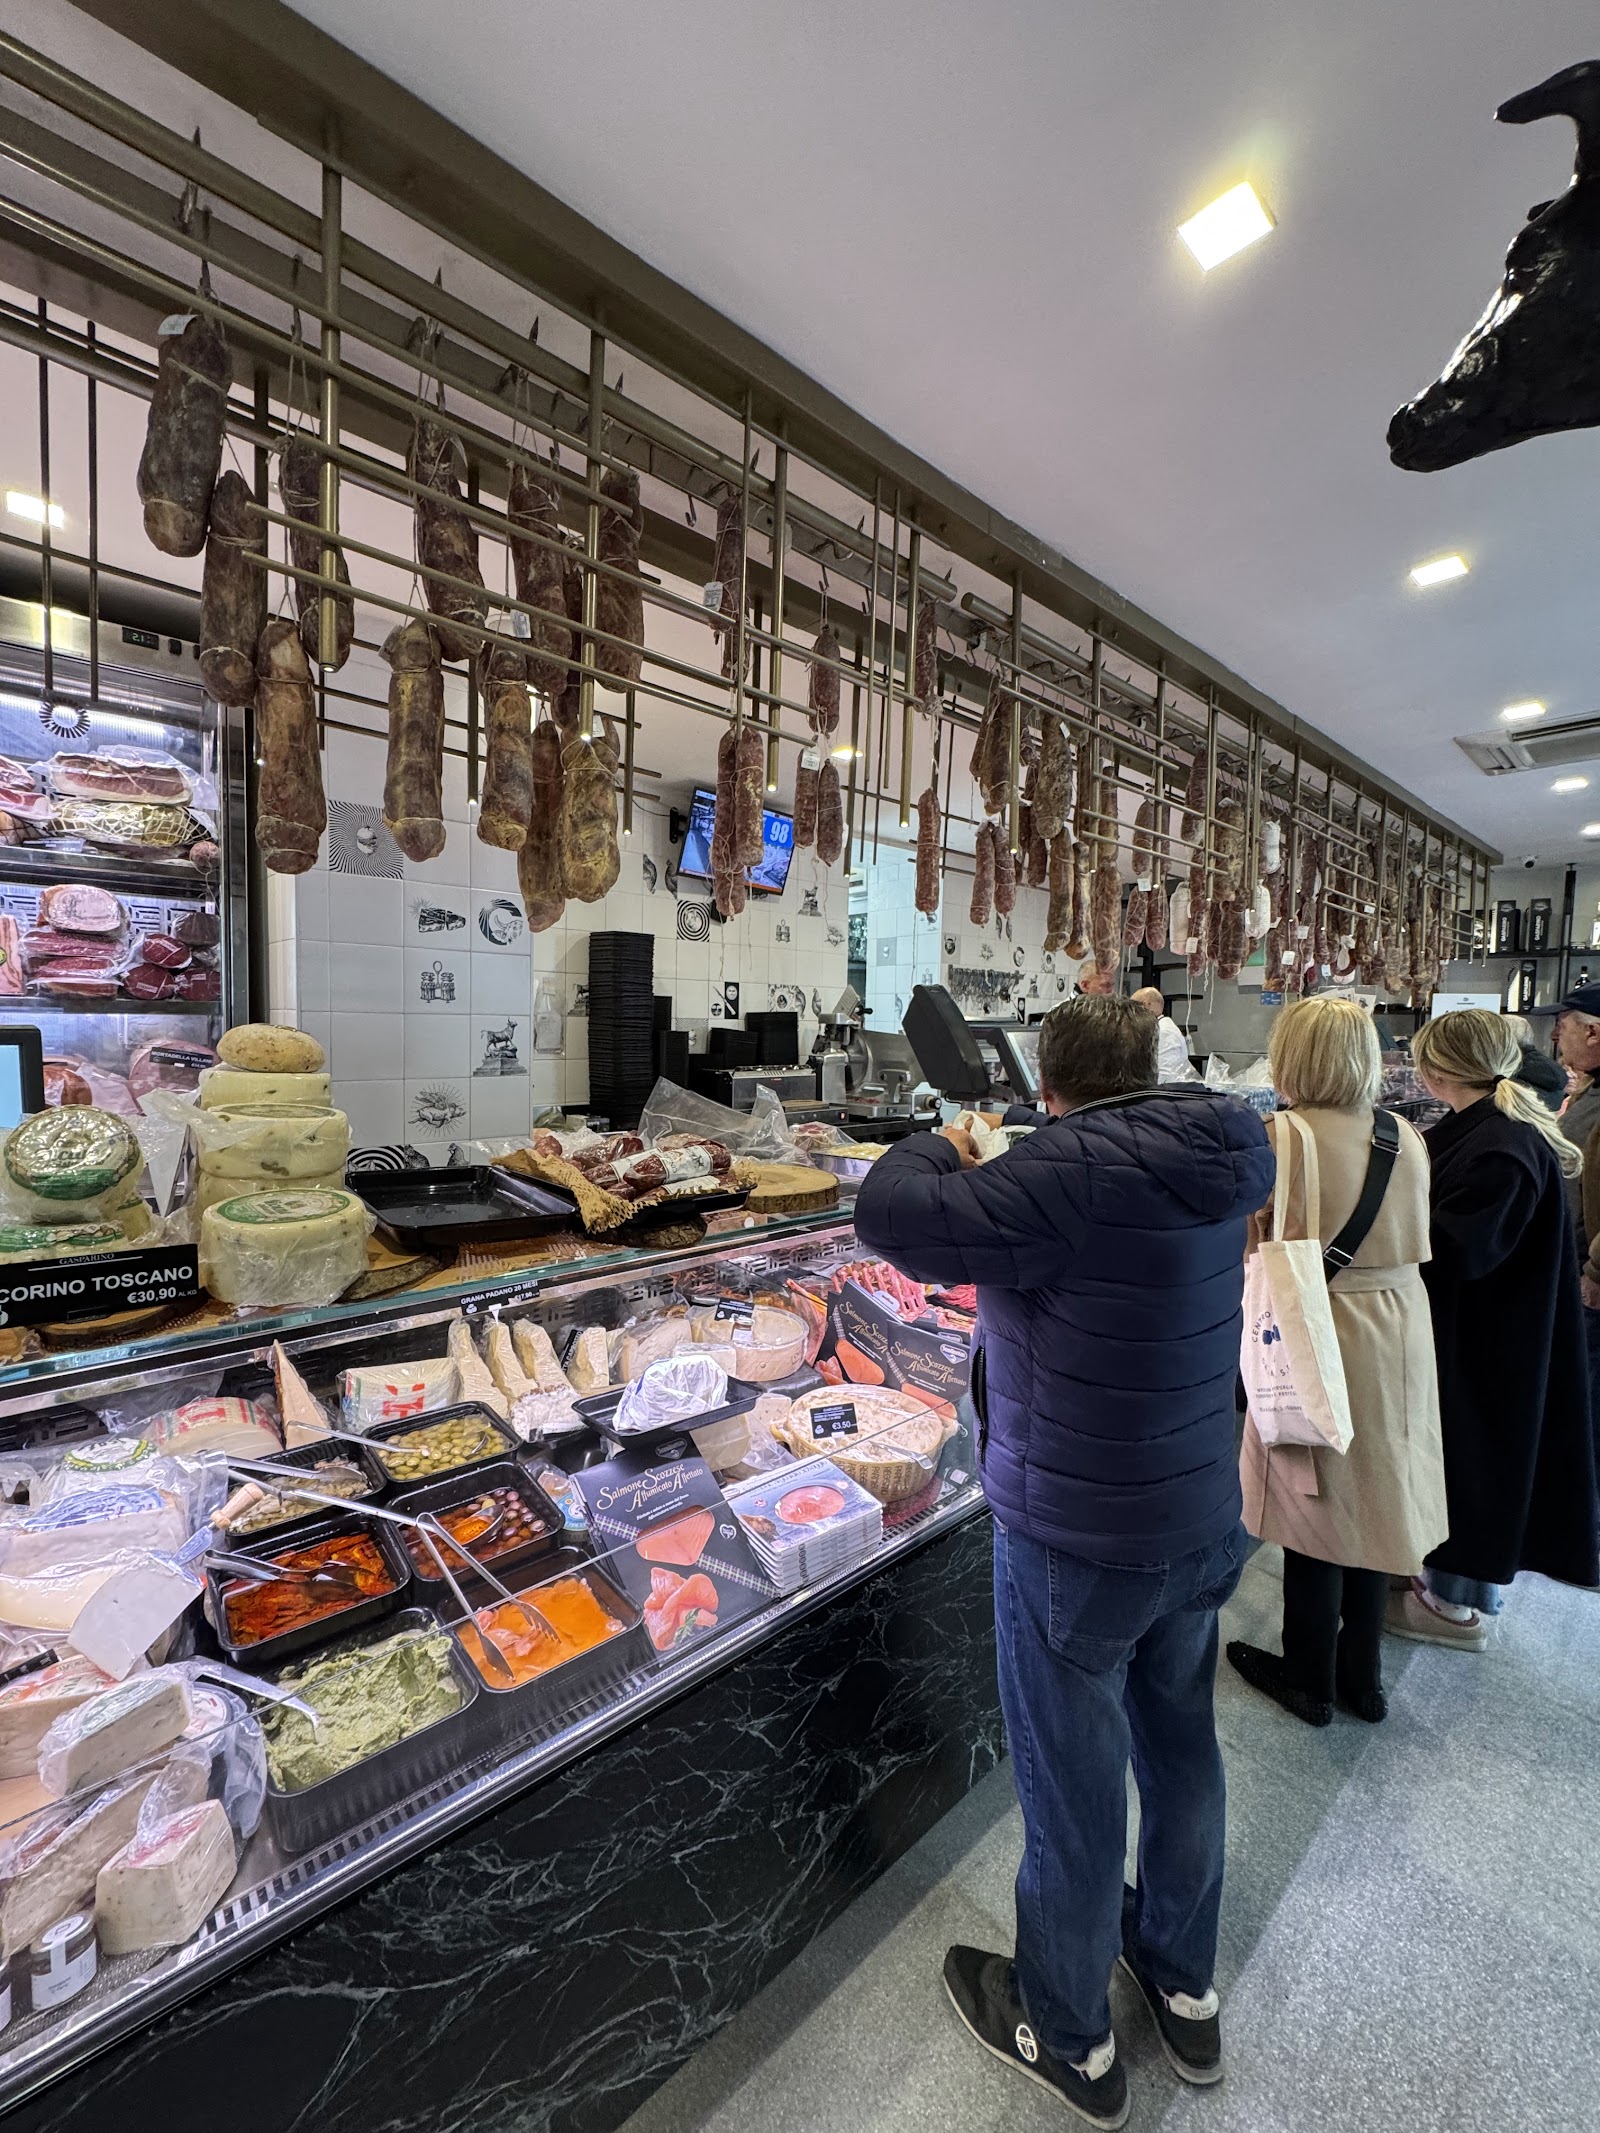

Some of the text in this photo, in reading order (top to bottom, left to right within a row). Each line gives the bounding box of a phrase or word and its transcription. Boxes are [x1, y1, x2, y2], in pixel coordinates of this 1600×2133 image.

[770, 821, 789, 844] 98
[151, 1051, 191, 1061] MORTADELLA
[59, 1252, 115, 1265] GASPARINO
[92, 1266, 193, 1292] TOSCANO
[127, 1287, 177, 1304] €30,90
[460, 1294, 486, 1305] GRANA
[485, 1286, 514, 1299] PADANO
[522, 1280, 539, 1290] MESI
[839, 1301, 888, 1345] Salmone Scozz
[848, 1323, 881, 1347] Affumicato
[1251, 1311, 1271, 1343] CENTRO
[890, 1341, 921, 1361] Salmone
[919, 1352, 955, 1374] Scozzese
[904, 1360, 940, 1378] Affumicato
[934, 1370, 967, 1387] Affettato
[596, 1480, 643, 1510] Salmone
[641, 1463, 685, 1490] Scozzese
[625, 1482, 673, 1513] Affumicato
[667, 1468, 703, 1493] Affettato
